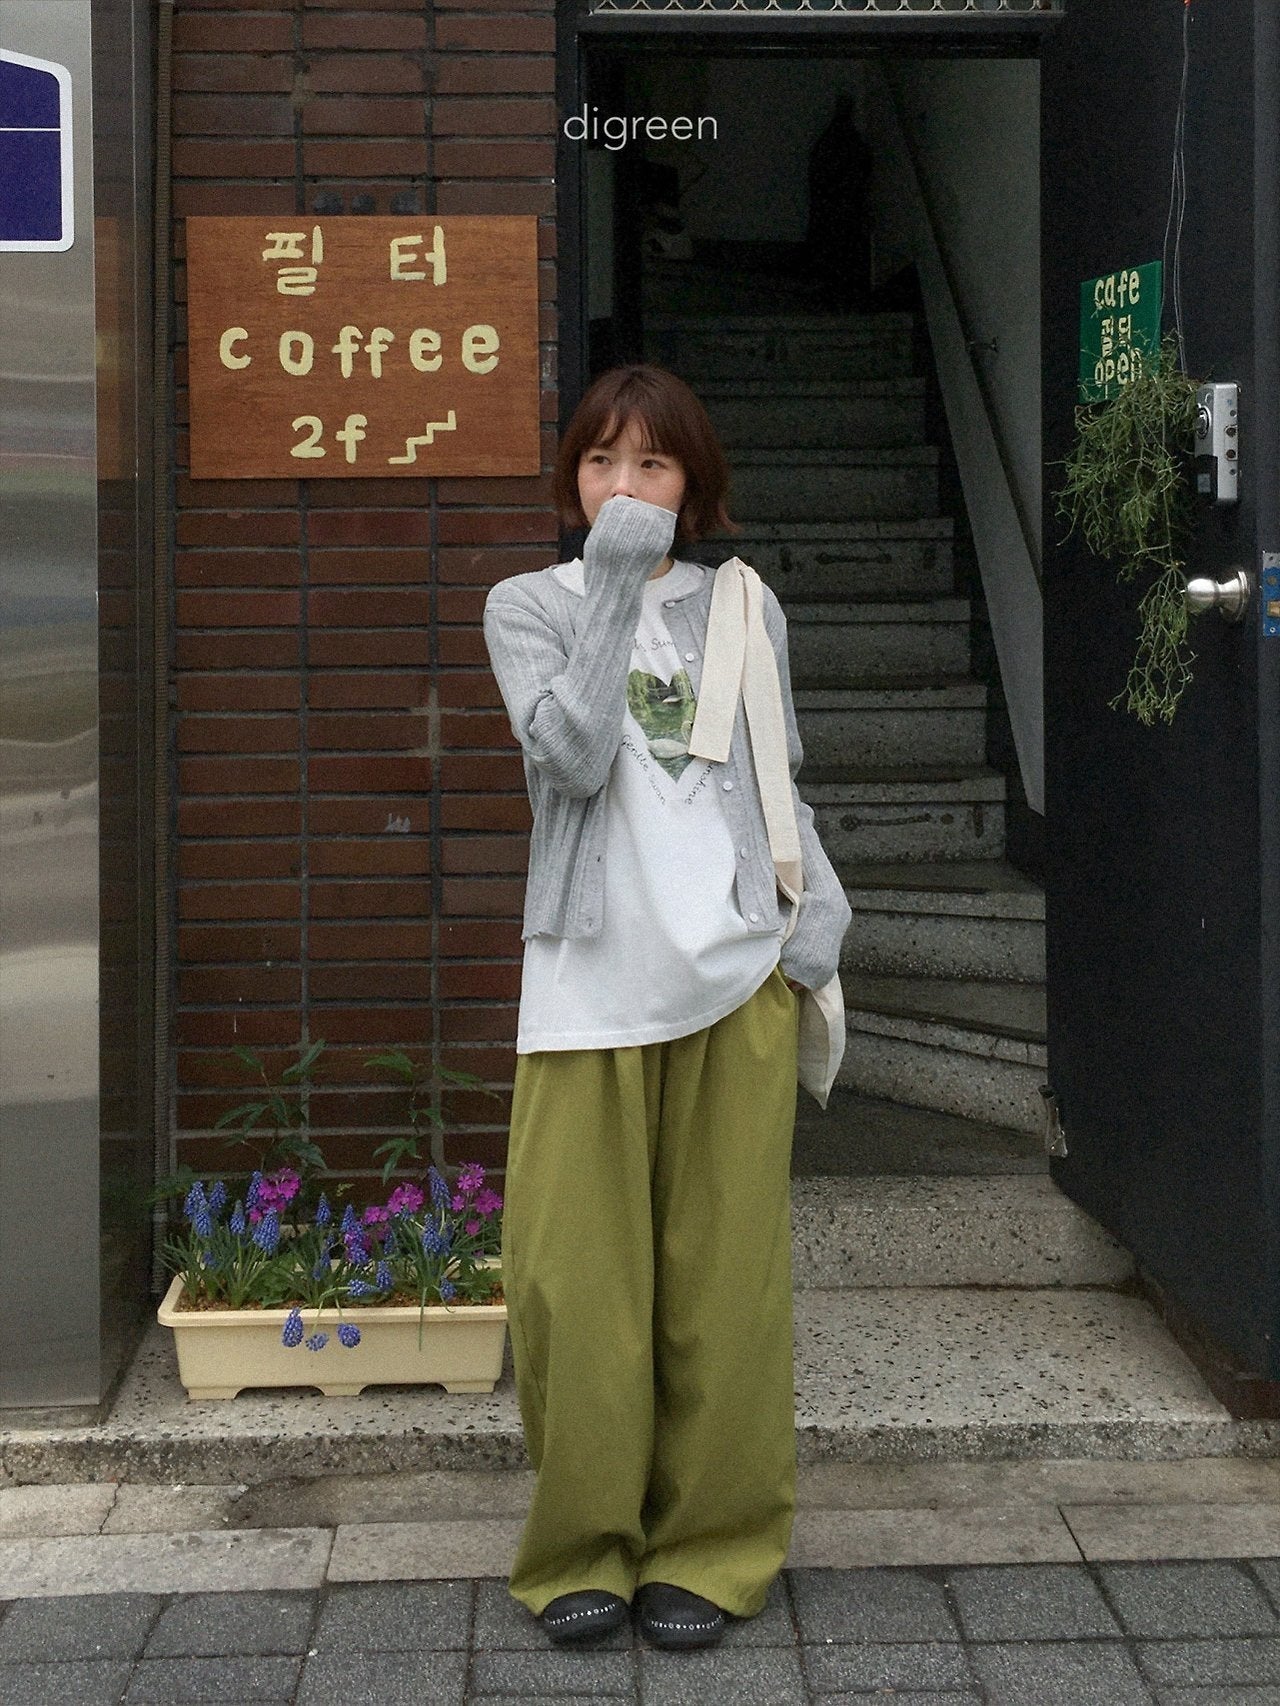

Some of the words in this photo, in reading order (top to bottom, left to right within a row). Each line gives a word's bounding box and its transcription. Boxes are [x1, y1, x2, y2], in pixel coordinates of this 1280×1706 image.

[1094, 270, 1140, 310] cafe
[219, 324, 500, 379] coffee
[1095, 347, 1143, 400] open
[290, 414, 368, 464] 2f
[685, 762, 715, 804] unshine
